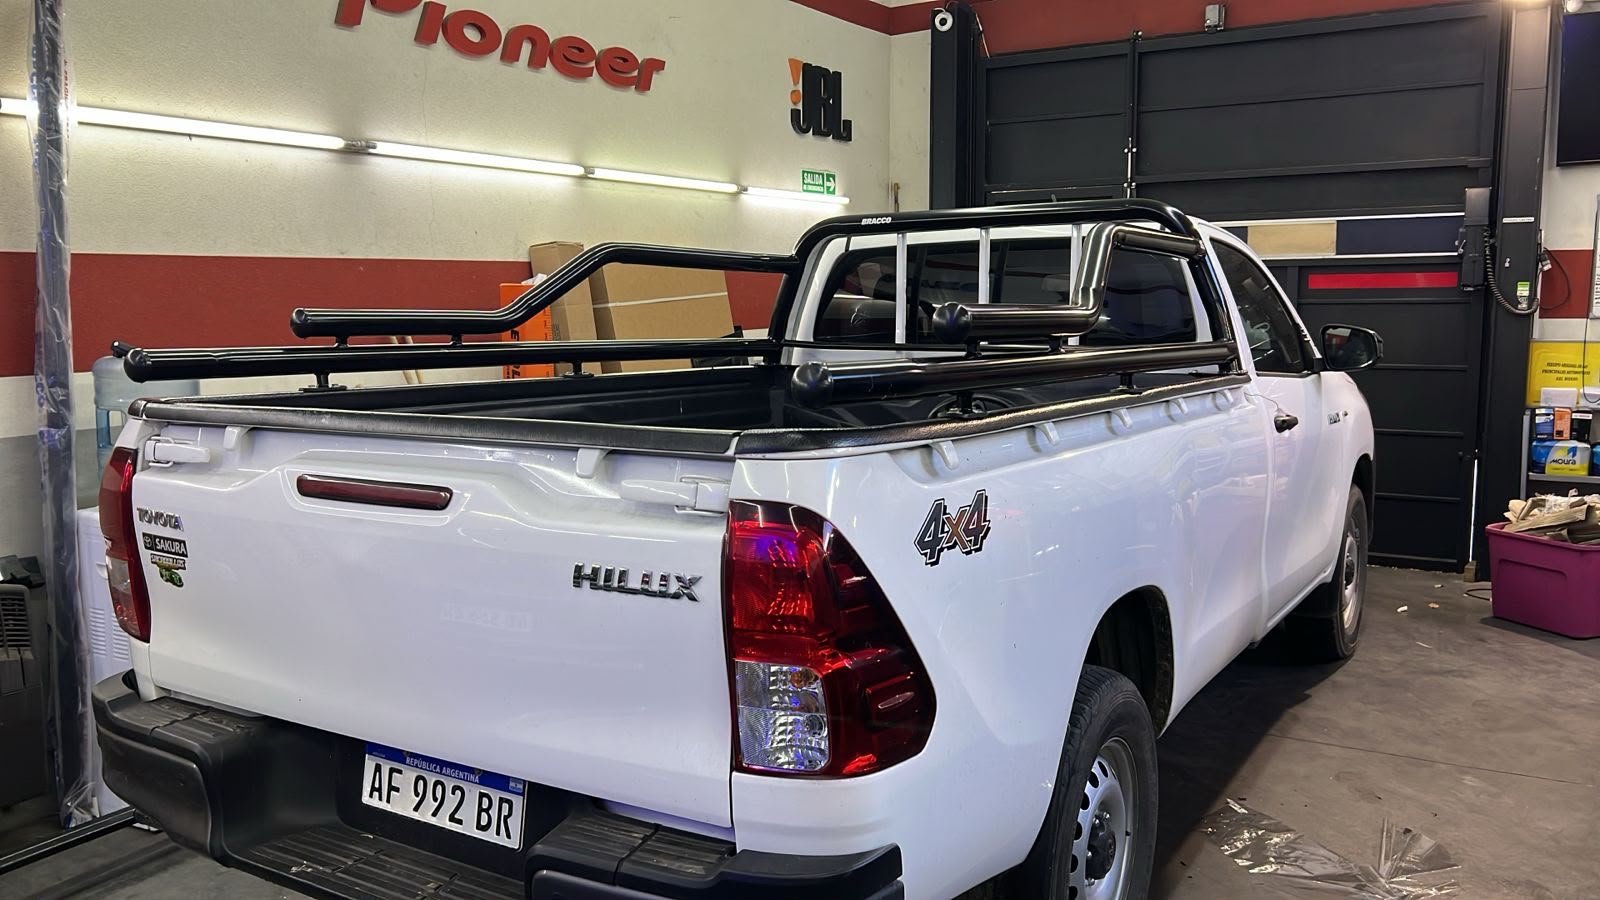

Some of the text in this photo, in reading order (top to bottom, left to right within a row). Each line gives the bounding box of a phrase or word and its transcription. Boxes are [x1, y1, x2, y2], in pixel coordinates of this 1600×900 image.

[790, 62, 852, 142] JBL
[803, 172, 823, 186] SALIDA
[861, 217, 892, 225] BRACCO
[137, 507, 184, 532] TOYOTA
[914, 489, 991, 567] 4x4
[155, 538, 187, 555] SAKURA
[573, 562, 702, 602] HILUX
[405, 756, 480, 784] REPÚBLICA ARGENTINA
[369, 763, 514, 840] AF 992 BR
